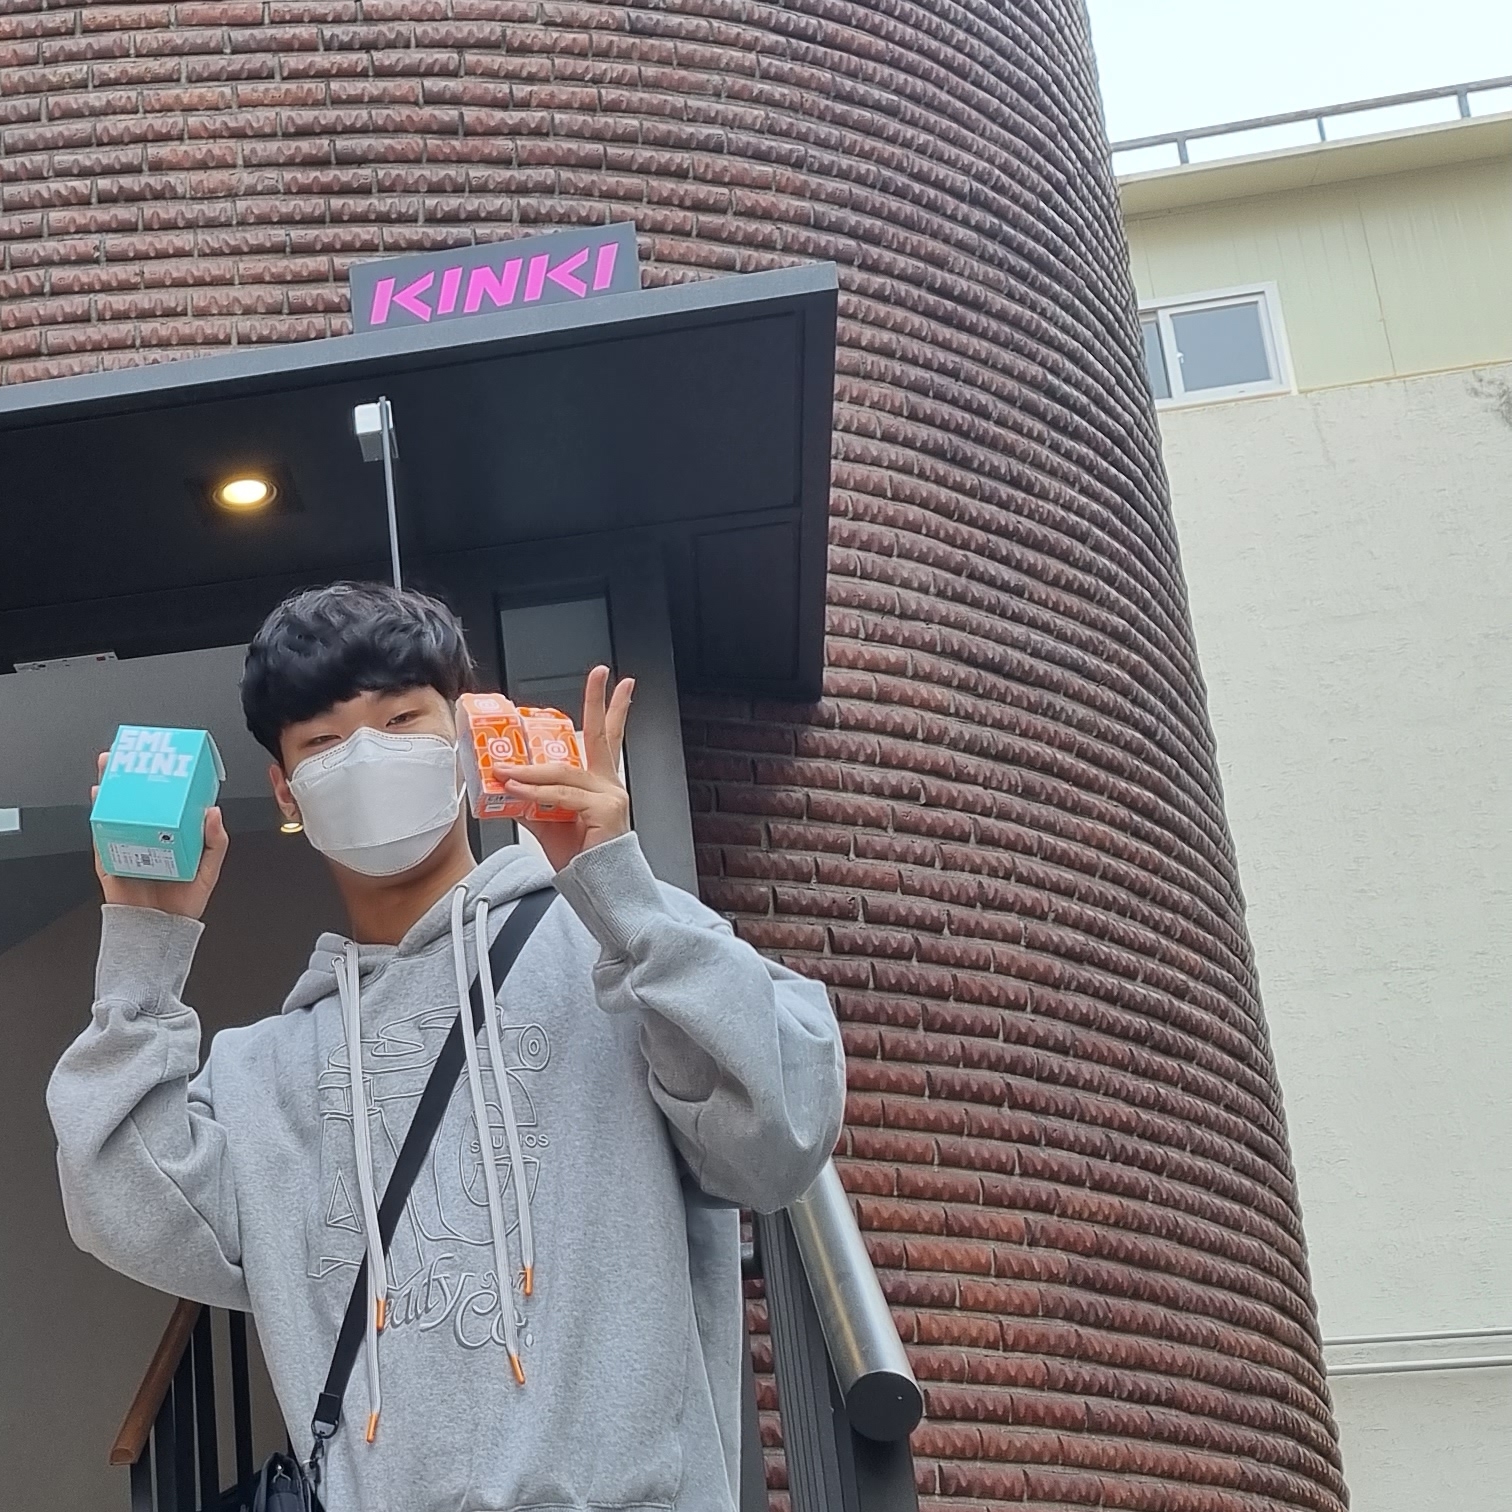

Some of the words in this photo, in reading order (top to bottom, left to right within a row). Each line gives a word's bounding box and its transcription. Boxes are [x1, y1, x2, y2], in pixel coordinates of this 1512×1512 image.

[370, 242, 619, 325] KINKI
[116, 729, 177, 752] SML
[110, 751, 194, 778] MINI
[470, 1133, 549, 1153] SUIOS
